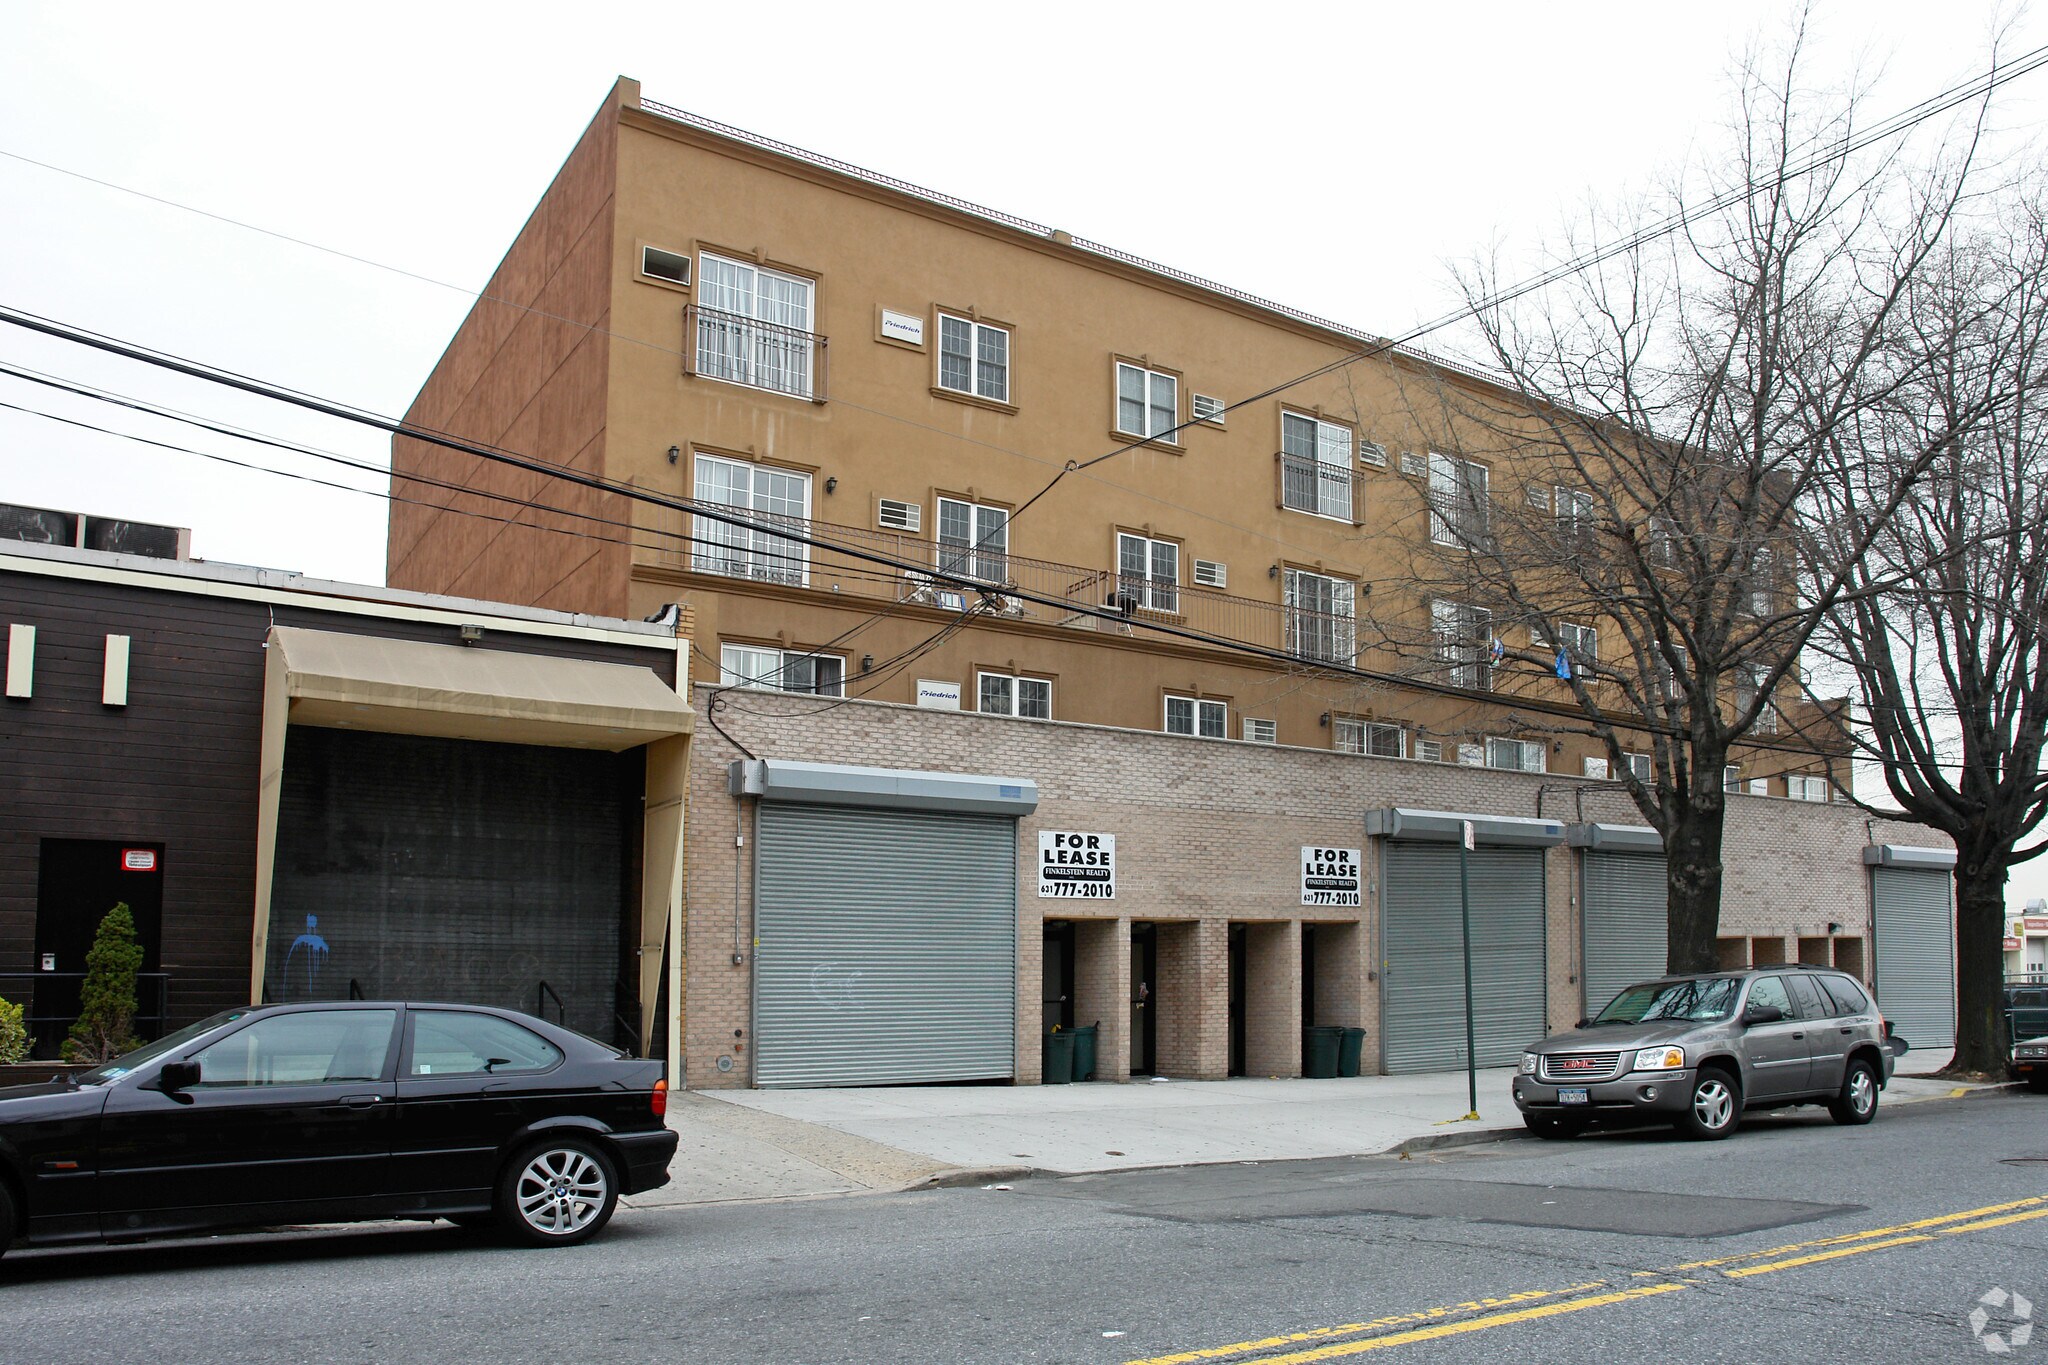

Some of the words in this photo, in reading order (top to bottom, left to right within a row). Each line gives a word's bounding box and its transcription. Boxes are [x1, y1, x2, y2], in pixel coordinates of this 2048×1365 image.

[885, 319, 920, 334] Friedrich
[920, 690, 958, 700] Friedrich
[1055, 834, 1100, 849] FOR
[1044, 850, 1110, 866] LEASE
[1314, 849, 1349, 863] FOR
[1045, 867, 1085, 876] FINKELSTEIN
[1086, 869, 1109, 877] REALTY
[1306, 863, 1357, 877] LEASE
[1307, 878, 1338, 886] FINKELSTEIN
[1041, 885, 1053, 893] 631
[1054, 882, 1112, 898] 777-2010
[1314, 892, 1359, 905] 777-2010
[1562, 1060, 1596, 1069] GMC
